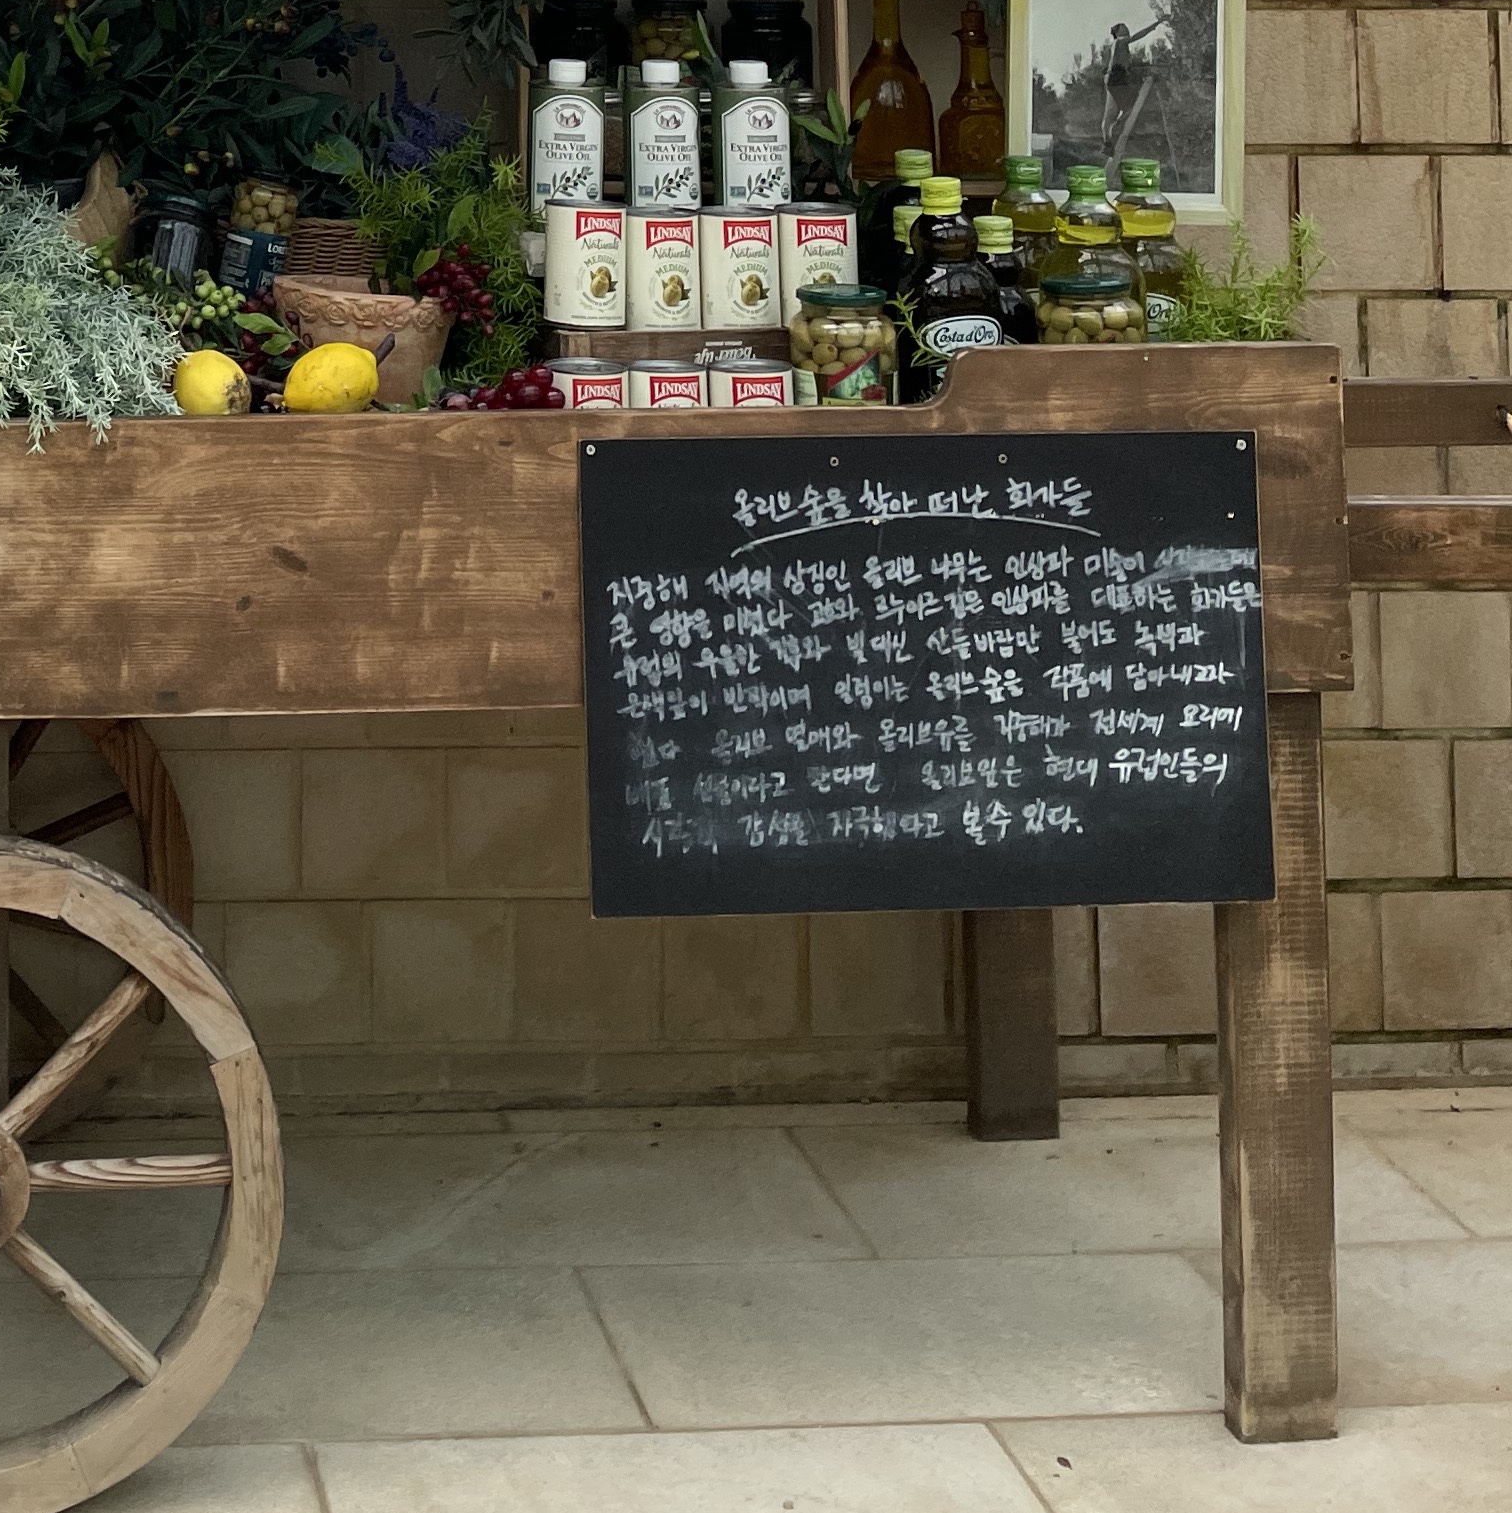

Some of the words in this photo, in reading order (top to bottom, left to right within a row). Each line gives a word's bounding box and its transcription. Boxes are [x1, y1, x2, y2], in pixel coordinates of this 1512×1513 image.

[539, 140, 568, 152] EXTRA
[639, 142, 669, 152] EXTRA
[730, 142, 762, 152] EXTRA
[546, 150, 574, 161] OLIVE
[647, 152, 675, 162] OLIVE
[739, 152, 768, 162] OLIVE
[579, 216, 621, 235] LINDSAY
[649, 225, 692, 244] LINDSAY
[727, 225, 771, 243] LINDSAY
[800, 223, 846, 242] LINDSAY
[581, 237, 620, 251] Naturals
[652, 245, 692, 259] Naturals
[730, 244, 771, 259] Naturals
[802, 243, 845, 258] Naturals
[583, 254, 617, 268] MEDIUM
[655, 263, 690, 277] MEDIUM
[732, 262, 769, 276] MEDIUM
[805, 261, 843, 274] MEDIUM
[934, 327, 964, 348] Costa
[576, 382, 621, 400] LINDSAY
[653, 380, 698, 399] LINDSAY
[735, 380, 782, 399] LINDSAY
[859, 478, 918, 516] 찾아
[927, 484, 997, 519] 떠난
[1006, 476, 1093, 517] 화가들
[607, 572, 689, 610] 지중해
[704, 565, 772, 600] 지역의
[784, 559, 851, 595] 상징인
[863, 555, 923, 589] 올리브
[931, 549, 992, 584] 나무는
[1004, 545, 1075, 581] 인상파
[649, 607, 714, 649] 영향을
[991, 580, 1072, 615] 인상파를
[1190, 580, 1262, 614] 화가들은
[1061, 619, 1117, 655] 불어도
[1134, 619, 1209, 657] 녹색과
[1042, 662, 1113, 702] 작품에
[785, 718, 863, 753] 열매와
[1179, 703, 1243, 732] 요리에
[1042, 743, 1099, 788] 현대
[1108, 746, 1229, 786] 유럽인들의
